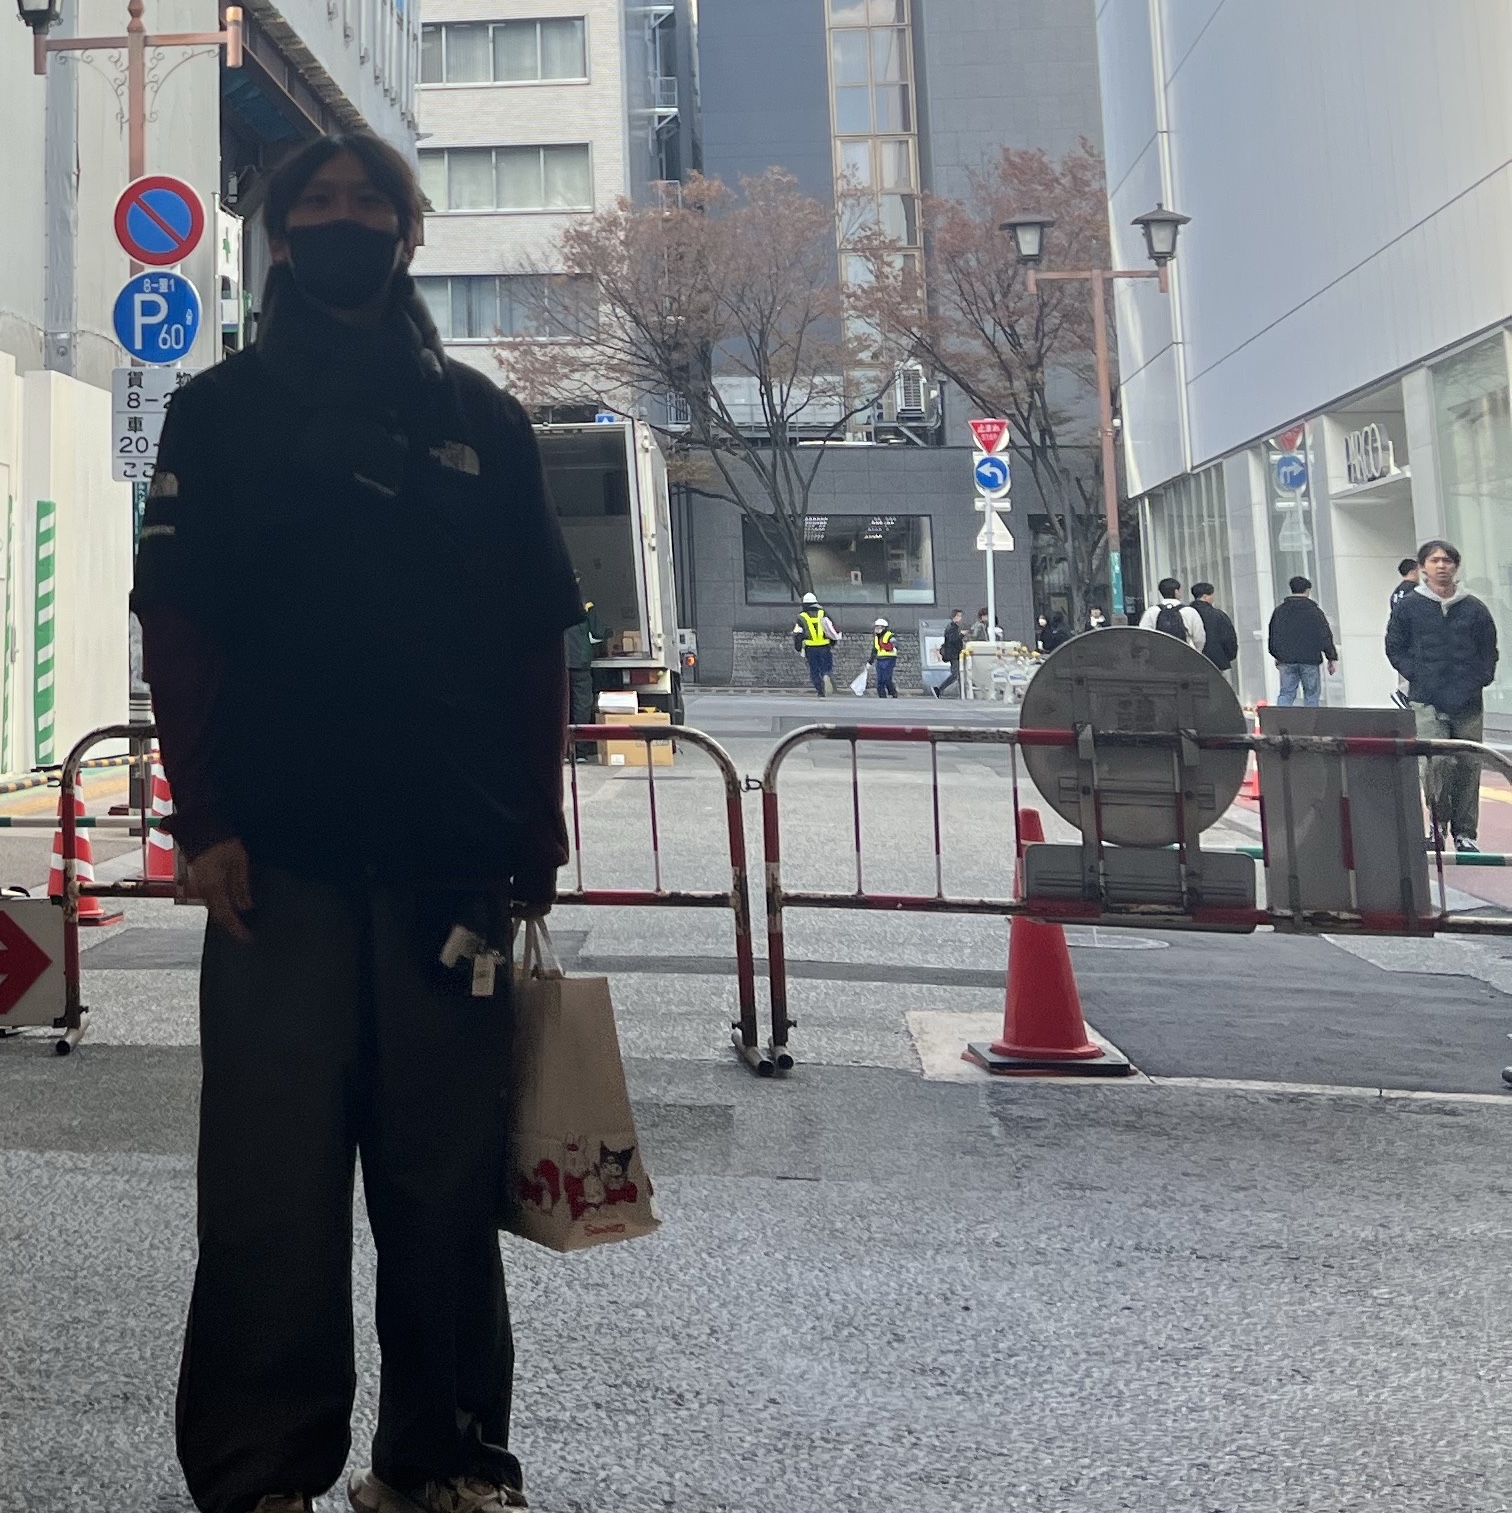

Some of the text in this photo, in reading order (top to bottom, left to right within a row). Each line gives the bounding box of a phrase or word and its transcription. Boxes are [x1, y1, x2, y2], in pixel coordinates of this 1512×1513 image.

[133, 292, 168, 350] P
[158, 324, 184, 350] 60
[126, 392, 173, 409] 8-2
[127, 416, 144, 434] 車
[119, 436, 159, 454] 20-
[123, 462, 156, 478] ここ
